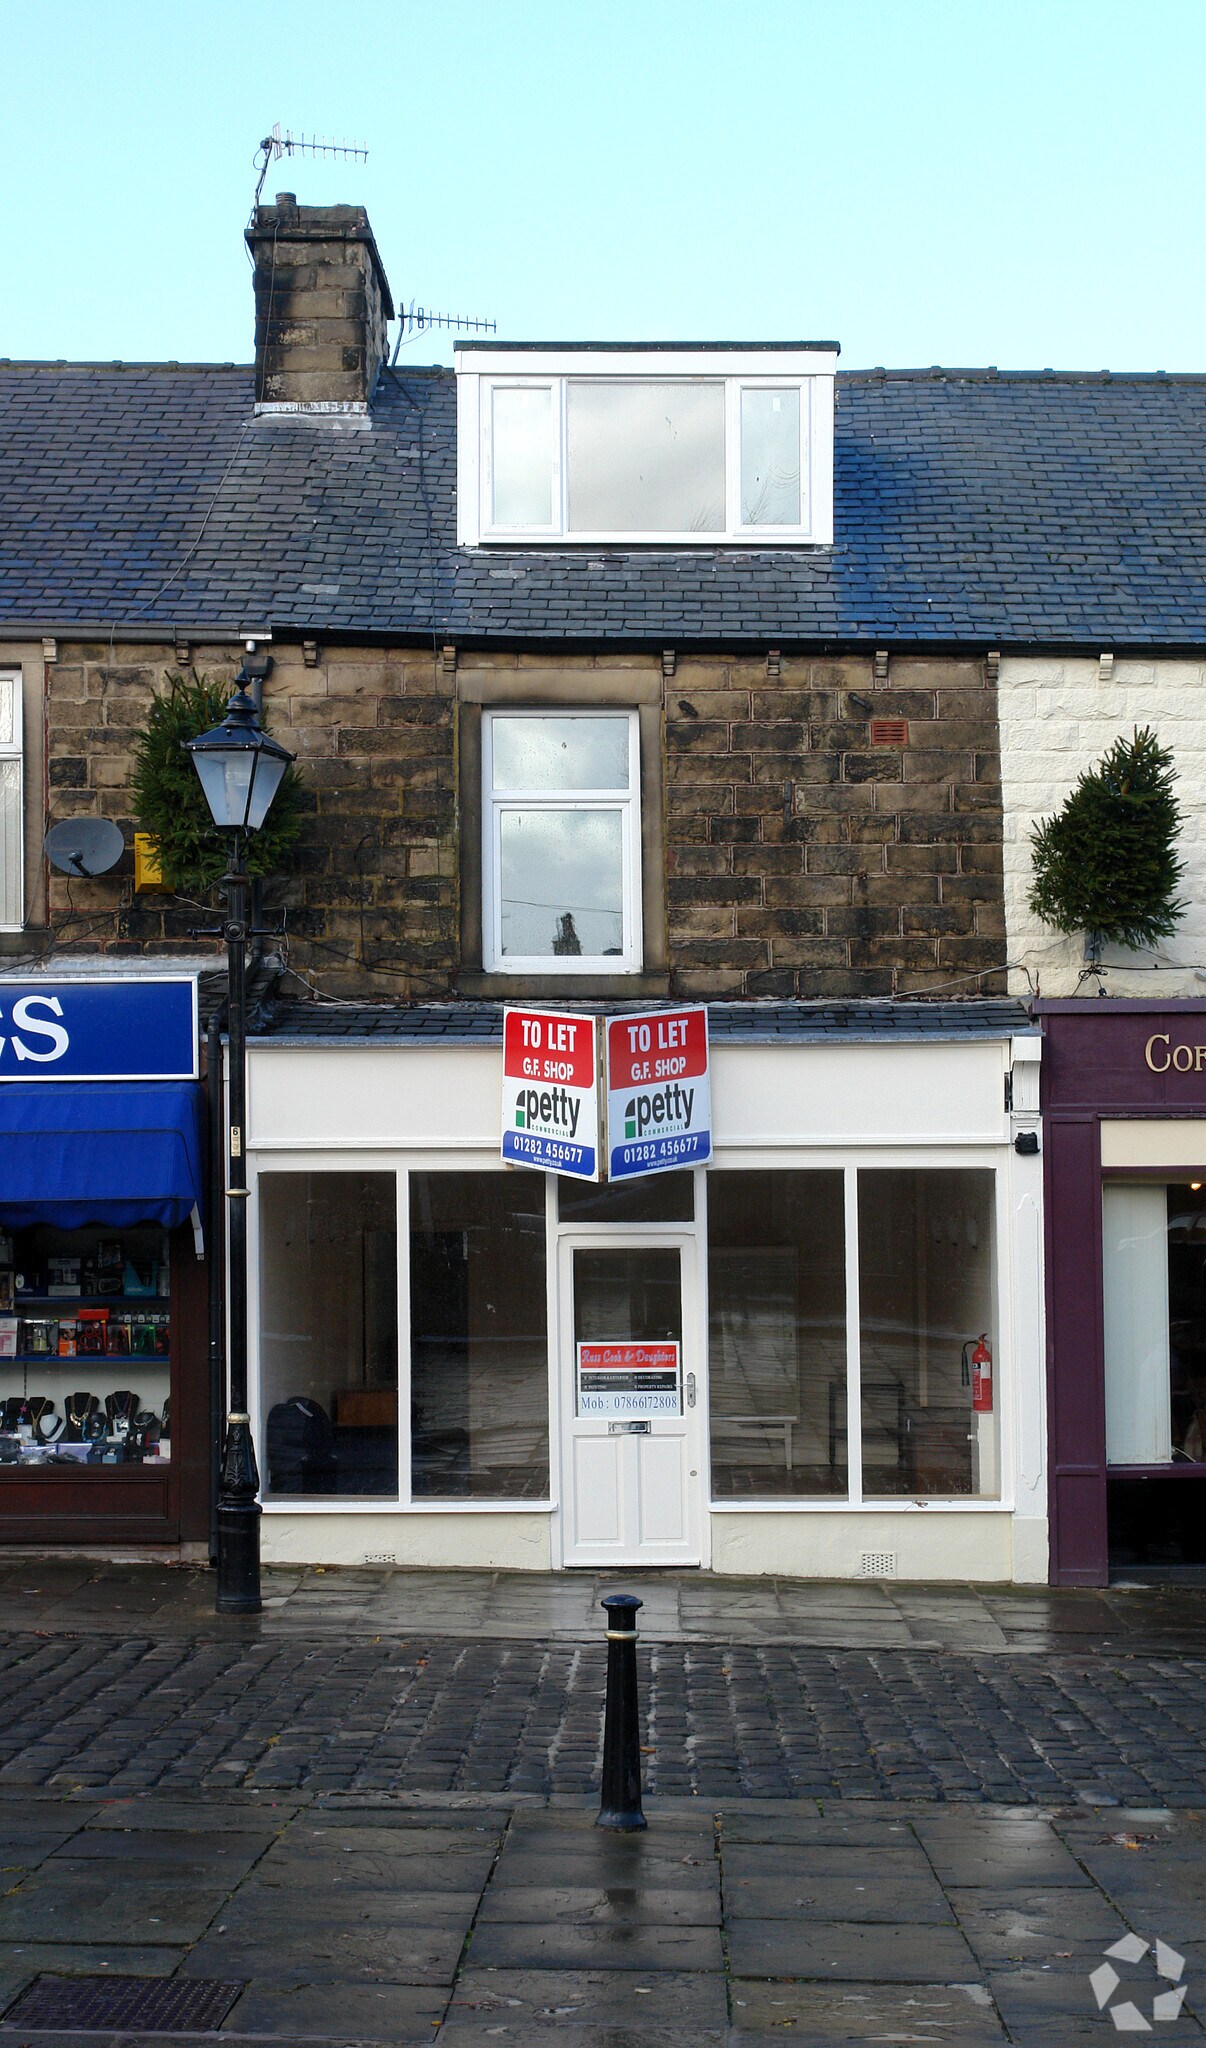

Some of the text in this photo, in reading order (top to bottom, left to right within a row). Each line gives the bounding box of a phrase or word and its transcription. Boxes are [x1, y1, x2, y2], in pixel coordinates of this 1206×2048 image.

[0, 995, 70, 1062] S
[521, 1020, 577, 1052] TO LET
[627, 1019, 689, 1053] TO LET
[523, 1057, 574, 1081] G.F. SHOP
[631, 1056, 687, 1081] G.F. SHOP
[527, 1087, 581, 1138] petty
[637, 1083, 695, 1137] petty
[531, 1124, 569, 1137] COMMERCIAL
[643, 1125, 684, 1136] COMMERCIAL
[513, 1136, 583, 1163] 01282 456677
[624, 1136, 698, 1163] 01282 456677
[581, 1349, 601, 1363] Russ
[624, 1350, 635, 1363] &
[636, 1349, 675, 1366] Daughters
[614, 1396, 677, 1409] 07866172808
